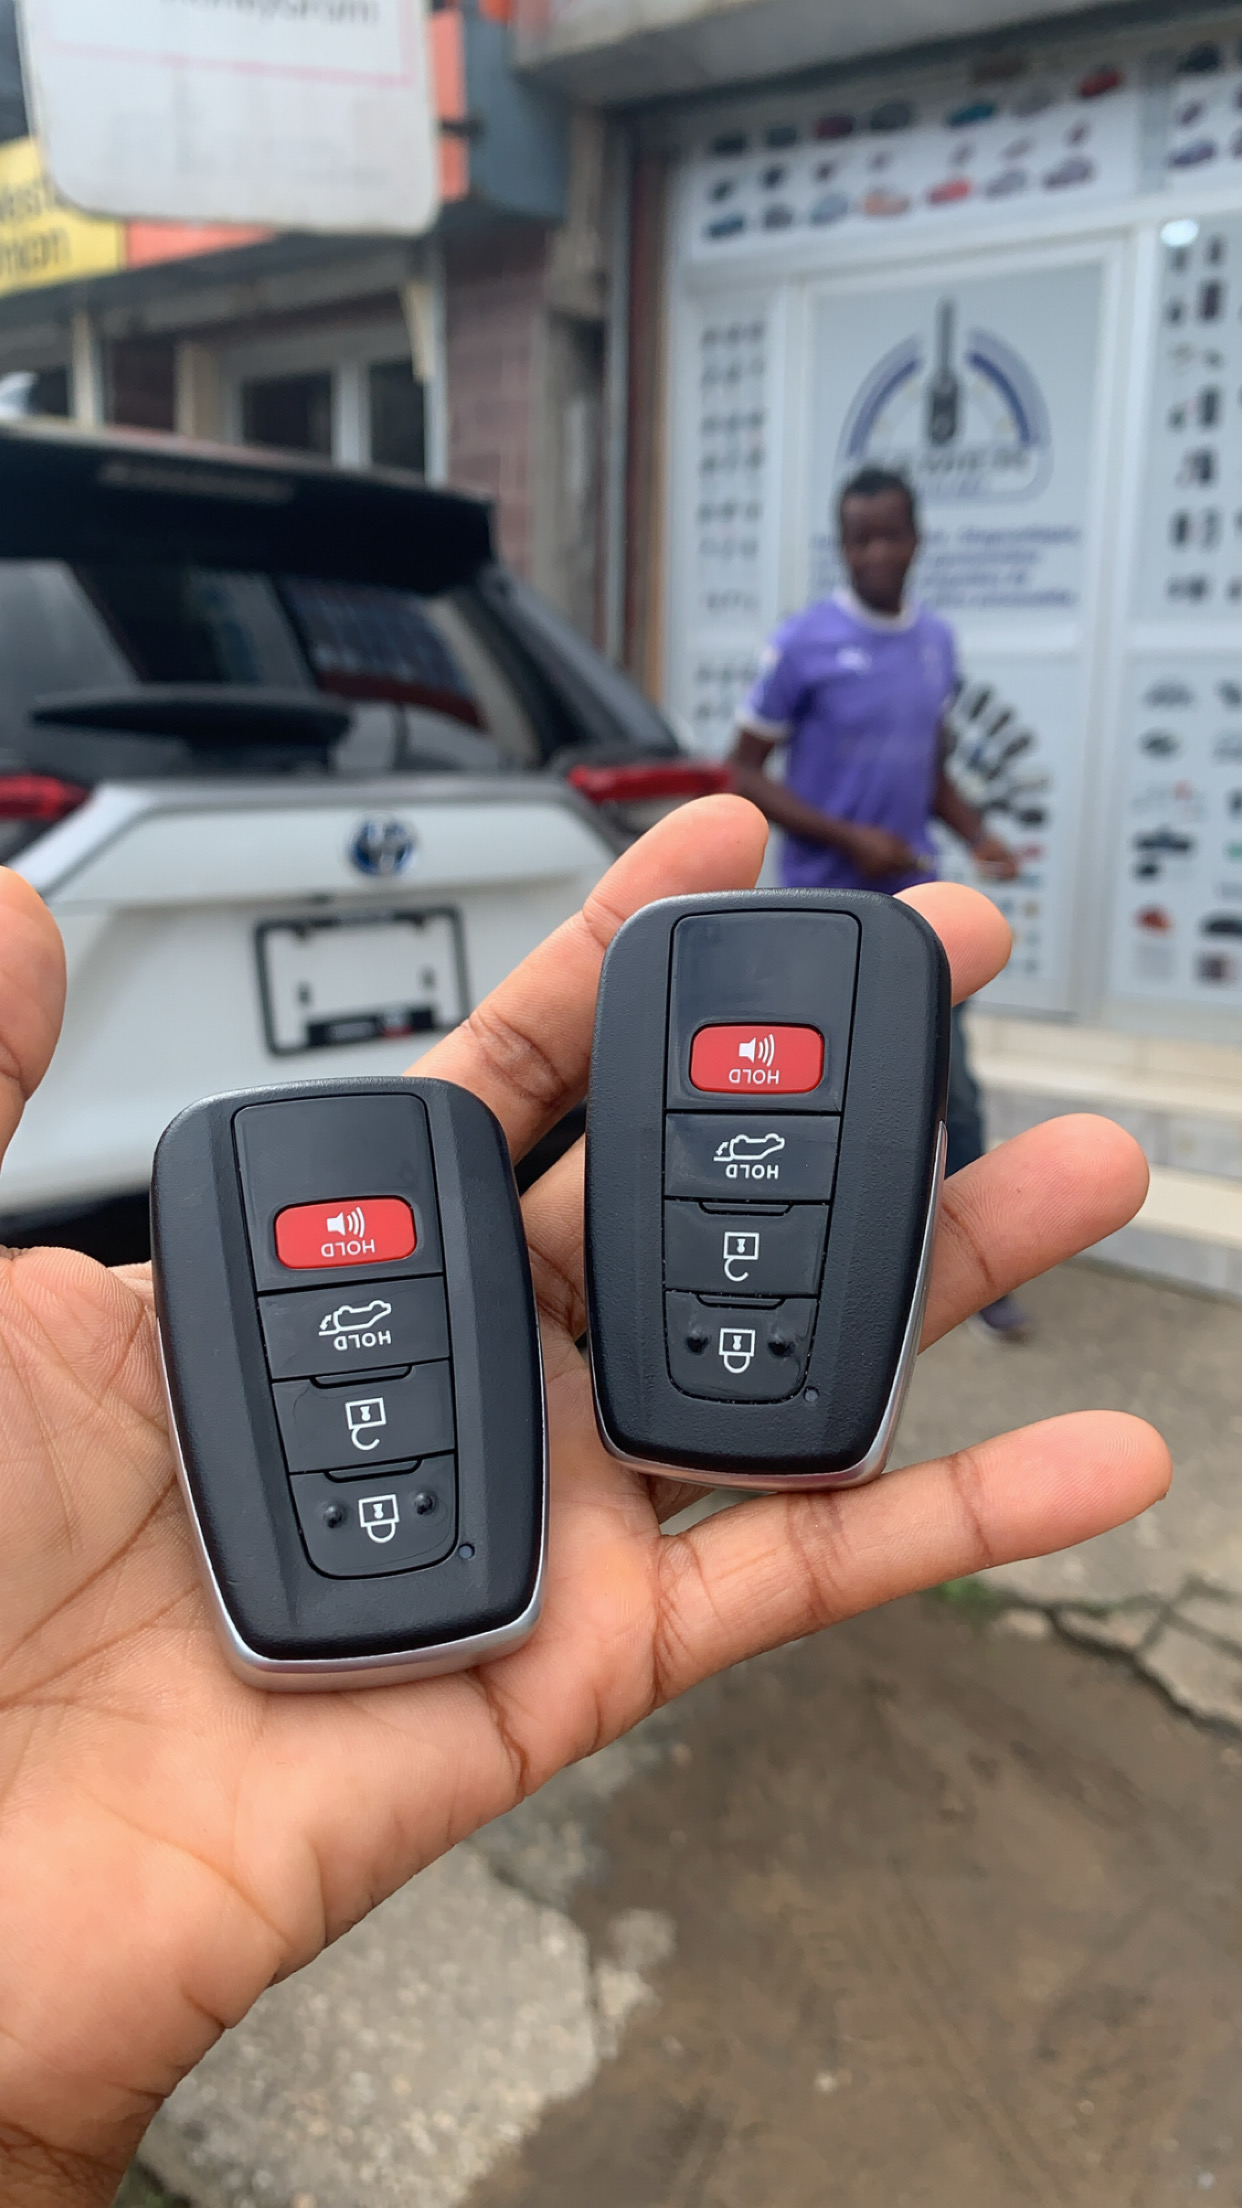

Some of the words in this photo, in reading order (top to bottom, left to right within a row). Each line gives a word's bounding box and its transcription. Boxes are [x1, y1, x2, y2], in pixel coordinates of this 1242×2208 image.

[728, 1068, 780, 1084] HOLD
[725, 1163, 780, 1179] HOLD
[321, 1239, 376, 1258] HOLD
[333, 1330, 392, 1351] HOLD
